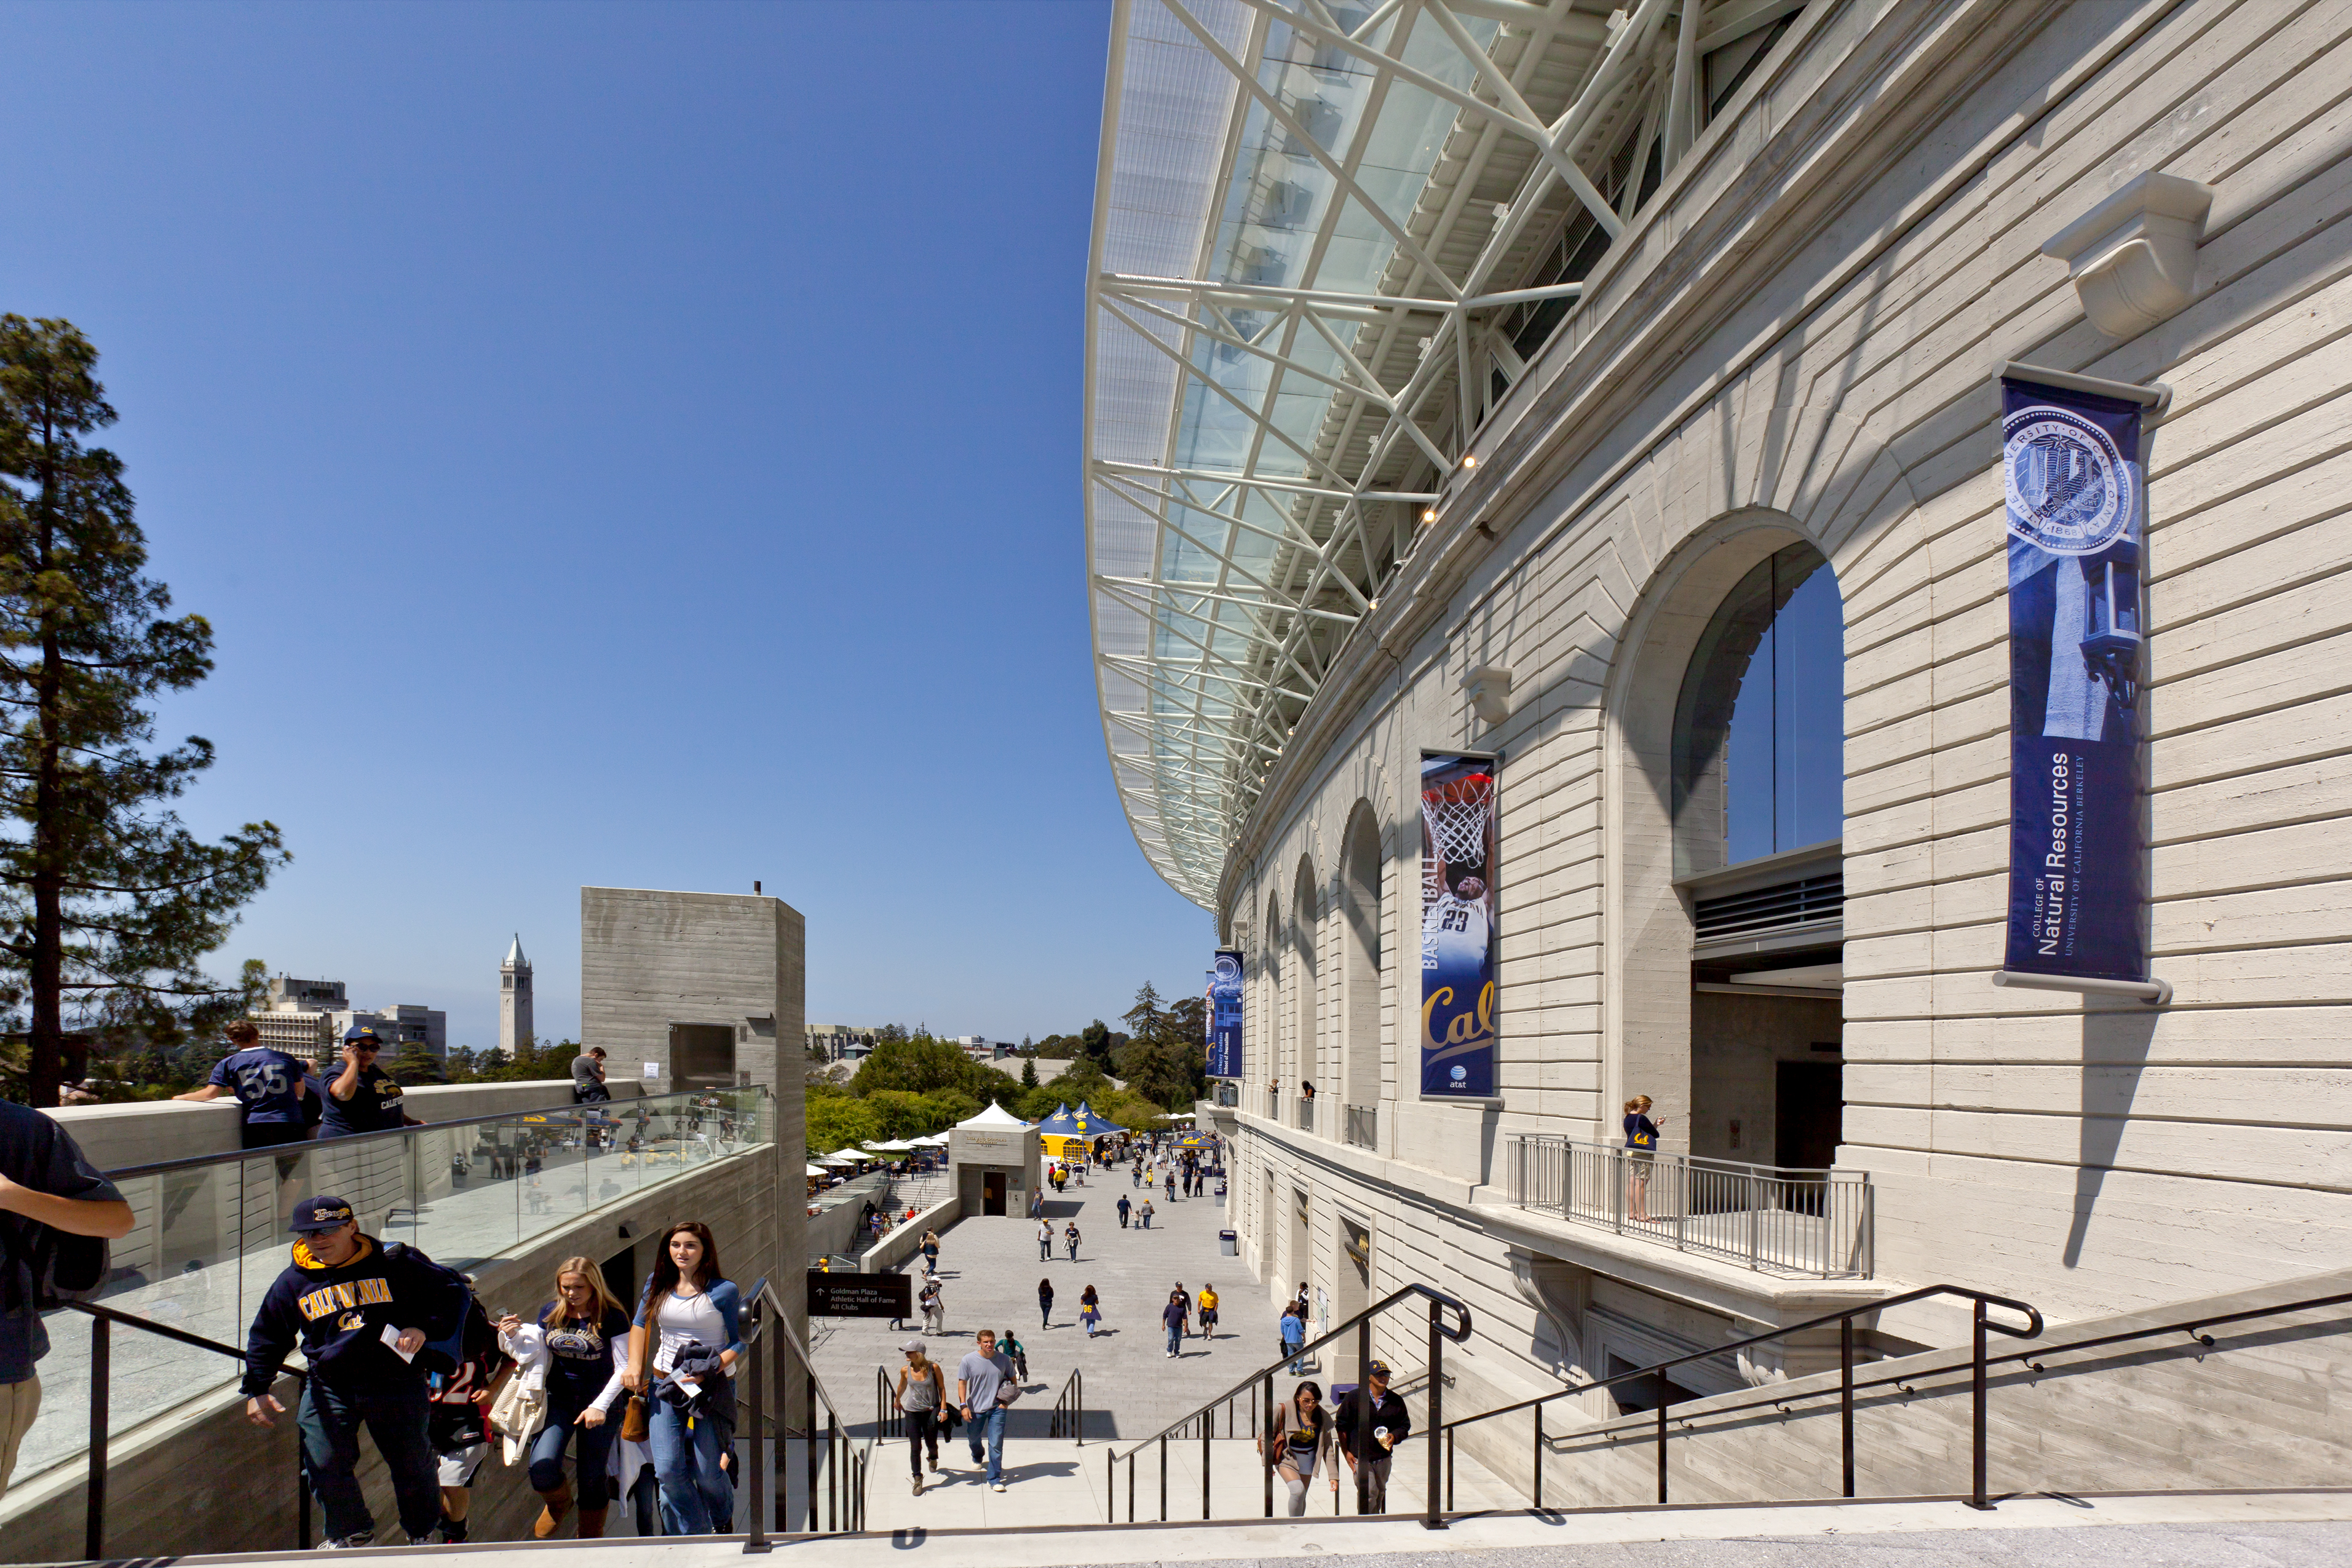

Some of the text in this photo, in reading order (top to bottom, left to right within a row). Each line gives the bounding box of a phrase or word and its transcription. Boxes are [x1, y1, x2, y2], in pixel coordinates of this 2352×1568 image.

[2005, 424, 2115, 529] THE UNIVERSITY OF CALIFORNIA
[2077, 496, 2097, 506] LIGHT
[2051, 525, 2078, 536] 1868
[2038, 753, 2069, 956] Natural Resources
[2073, 810, 2083, 874] CALIFORNIA
[2072, 877, 2080, 892] OF
[1421, 853, 1438, 970] BASKETBALL
[1441, 909, 1470, 933] 23
[2033, 877, 2044, 937] COLLEGE OF
[2065, 895, 2079, 956] UNIVERSITY
[1421, 981, 1494, 1050] Cal
[237, 1064, 288, 1099] 55
[1052, 1112, 1069, 1121] Cal
[1074, 1110, 1089, 1119] Cal
[1182, 1136, 1201, 1145] Cal
[1634, 1133, 1649, 1145] Cal
